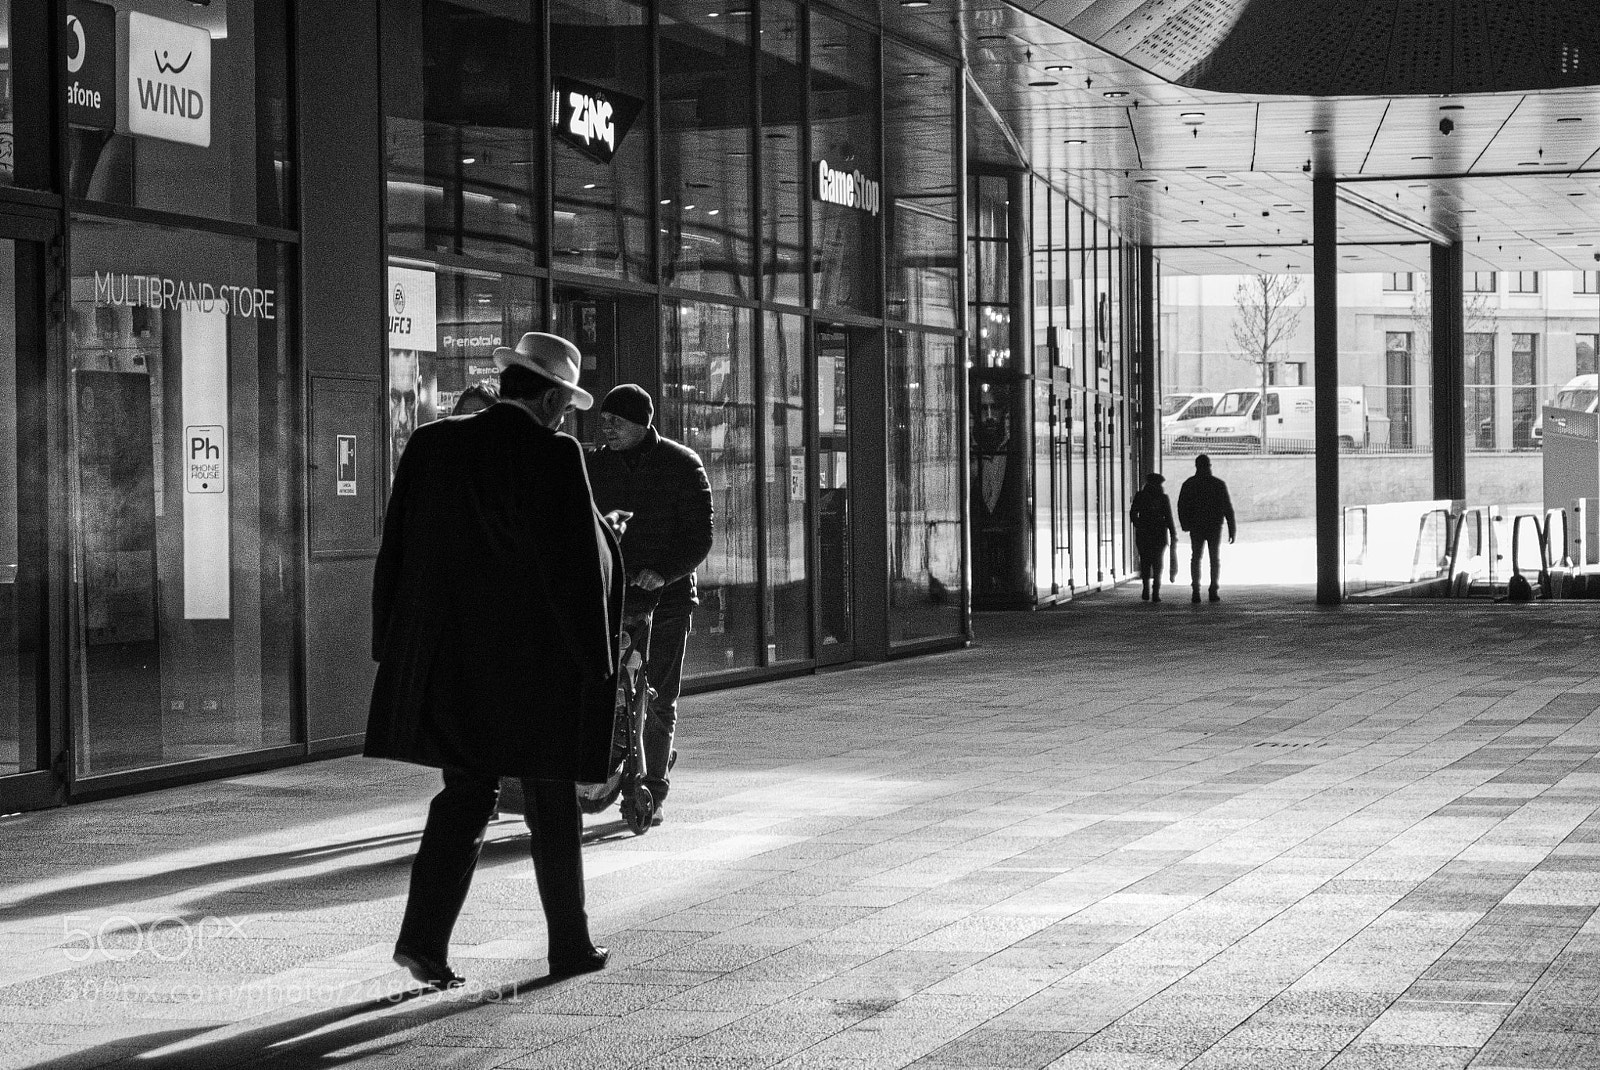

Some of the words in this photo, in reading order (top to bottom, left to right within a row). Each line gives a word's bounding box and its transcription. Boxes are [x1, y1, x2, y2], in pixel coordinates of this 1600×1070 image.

[67, 81, 101, 109] afone
[137, 78, 204, 120] WIND
[820, 160, 880, 216] GameStop
[95, 270, 215, 313] MULTIBRAND
[220, 284, 275, 319] STORE
[191, 437, 220, 460] Ph
[191, 464, 220, 472] PHONE
[191, 471, 220, 480] HOUSE
